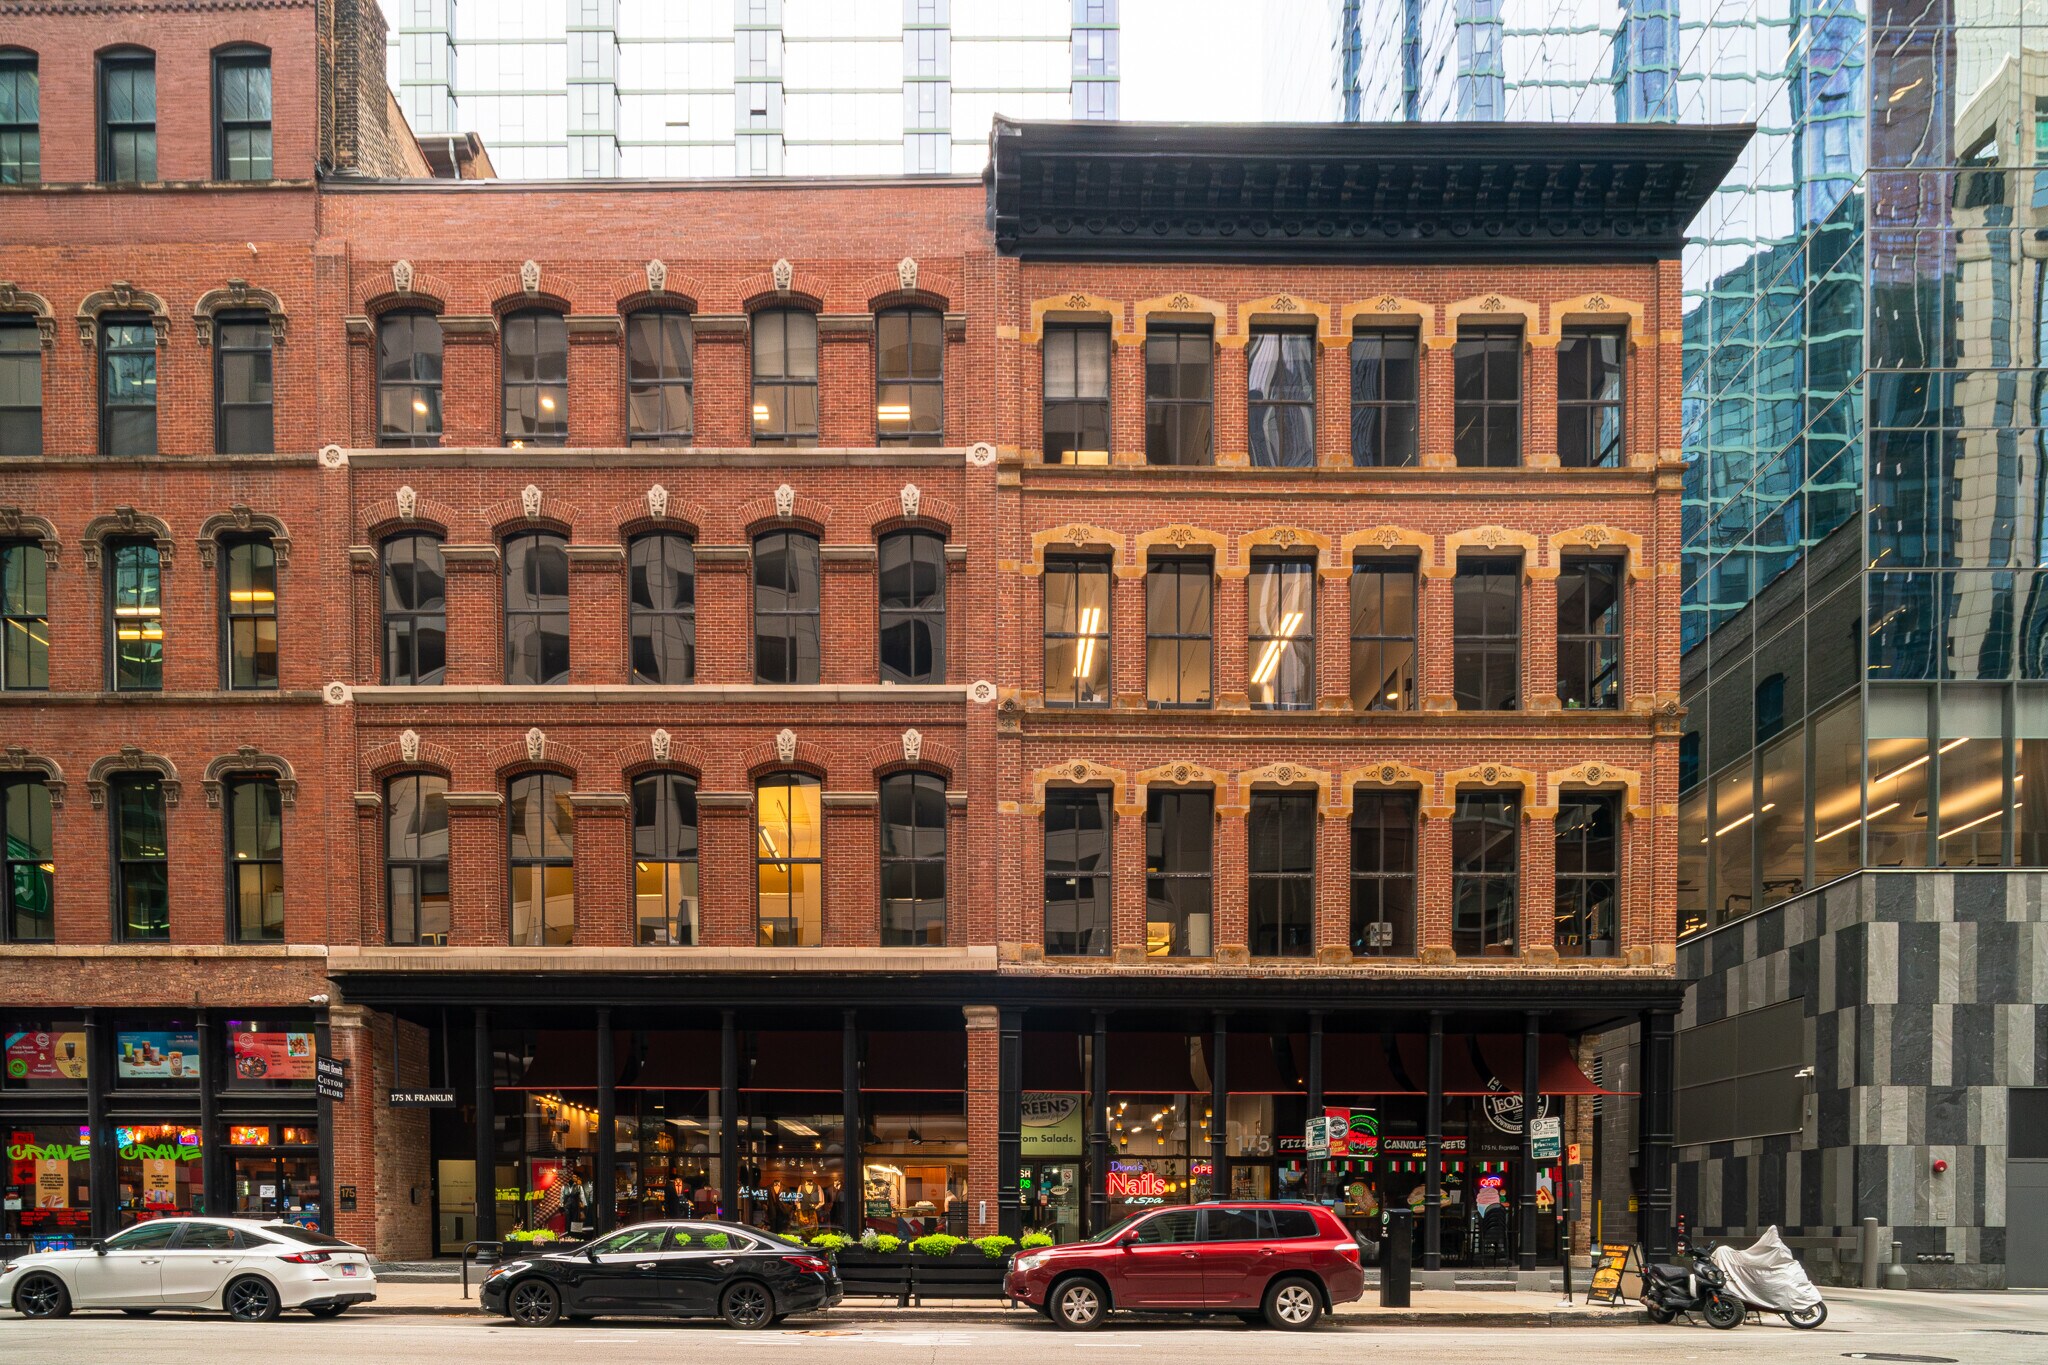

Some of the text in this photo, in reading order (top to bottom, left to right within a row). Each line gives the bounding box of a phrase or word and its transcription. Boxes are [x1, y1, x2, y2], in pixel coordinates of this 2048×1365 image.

[318, 1074, 343, 1088] CUSTOM
[318, 1085, 343, 1098] TAILORS
[391, 1094, 454, 1102] 175 N. FRANKLIN
[1021, 1099, 1070, 1116] REENS
[1491, 1094, 1523, 1115] LEON
[1493, 1115, 1523, 1131] DOWNRIGH
[1041, 1134, 1077, 1143] Salads.
[1235, 1135, 1270, 1152] 175
[1280, 1139, 1307, 1149] PIZZ
[1348, 1140, 1378, 1150] ICHES
[7, 1144, 90, 1161] CRAVE
[120, 1144, 202, 1161] CRAVE
[1111, 1161, 1144, 1172] Diana's
[1192, 1165, 1212, 1174] OPE
[1107, 1172, 1166, 1196] Nails
[1480, 1178, 1501, 1187] OPEN
[341, 1188, 356, 1198] 175
[1134, 1197, 1164, 1205] Spa
